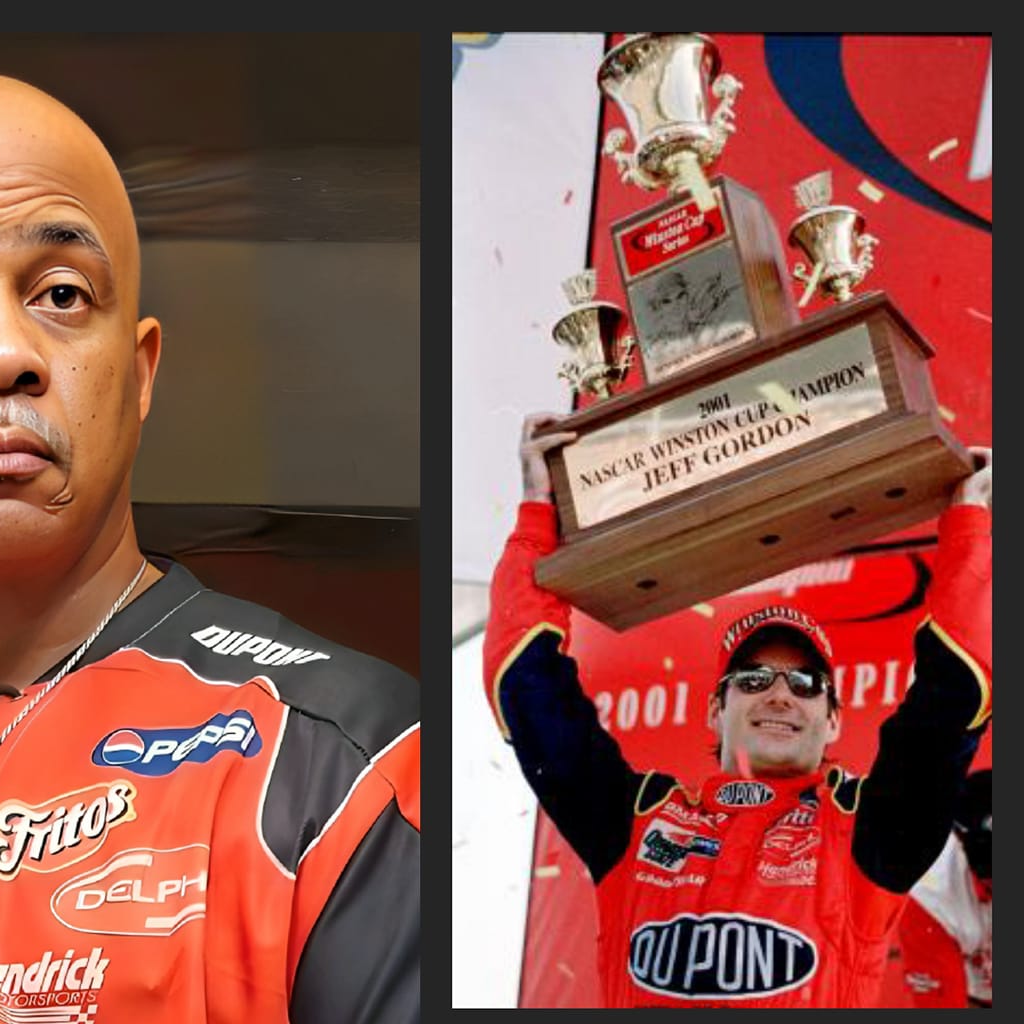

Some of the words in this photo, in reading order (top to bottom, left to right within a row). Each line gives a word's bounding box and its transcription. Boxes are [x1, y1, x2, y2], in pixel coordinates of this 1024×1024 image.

[580, 451, 645, 489] NASCAR
[649, 417, 731, 463] WINSTON
[734, 402, 769, 429] CUP
[772, 361, 867, 415] CAMPION
[697, 392, 731, 419] 2001
[642, 455, 697, 493] JEFF
[703, 410, 812, 465] GORDON
[191, 624, 331, 666] DUPONT
[142, 717, 256, 763] PEPSI
[75, 871, 207, 911] DELPH
[633, 923, 681, 986] DU
[683, 921, 804, 991] PONT
